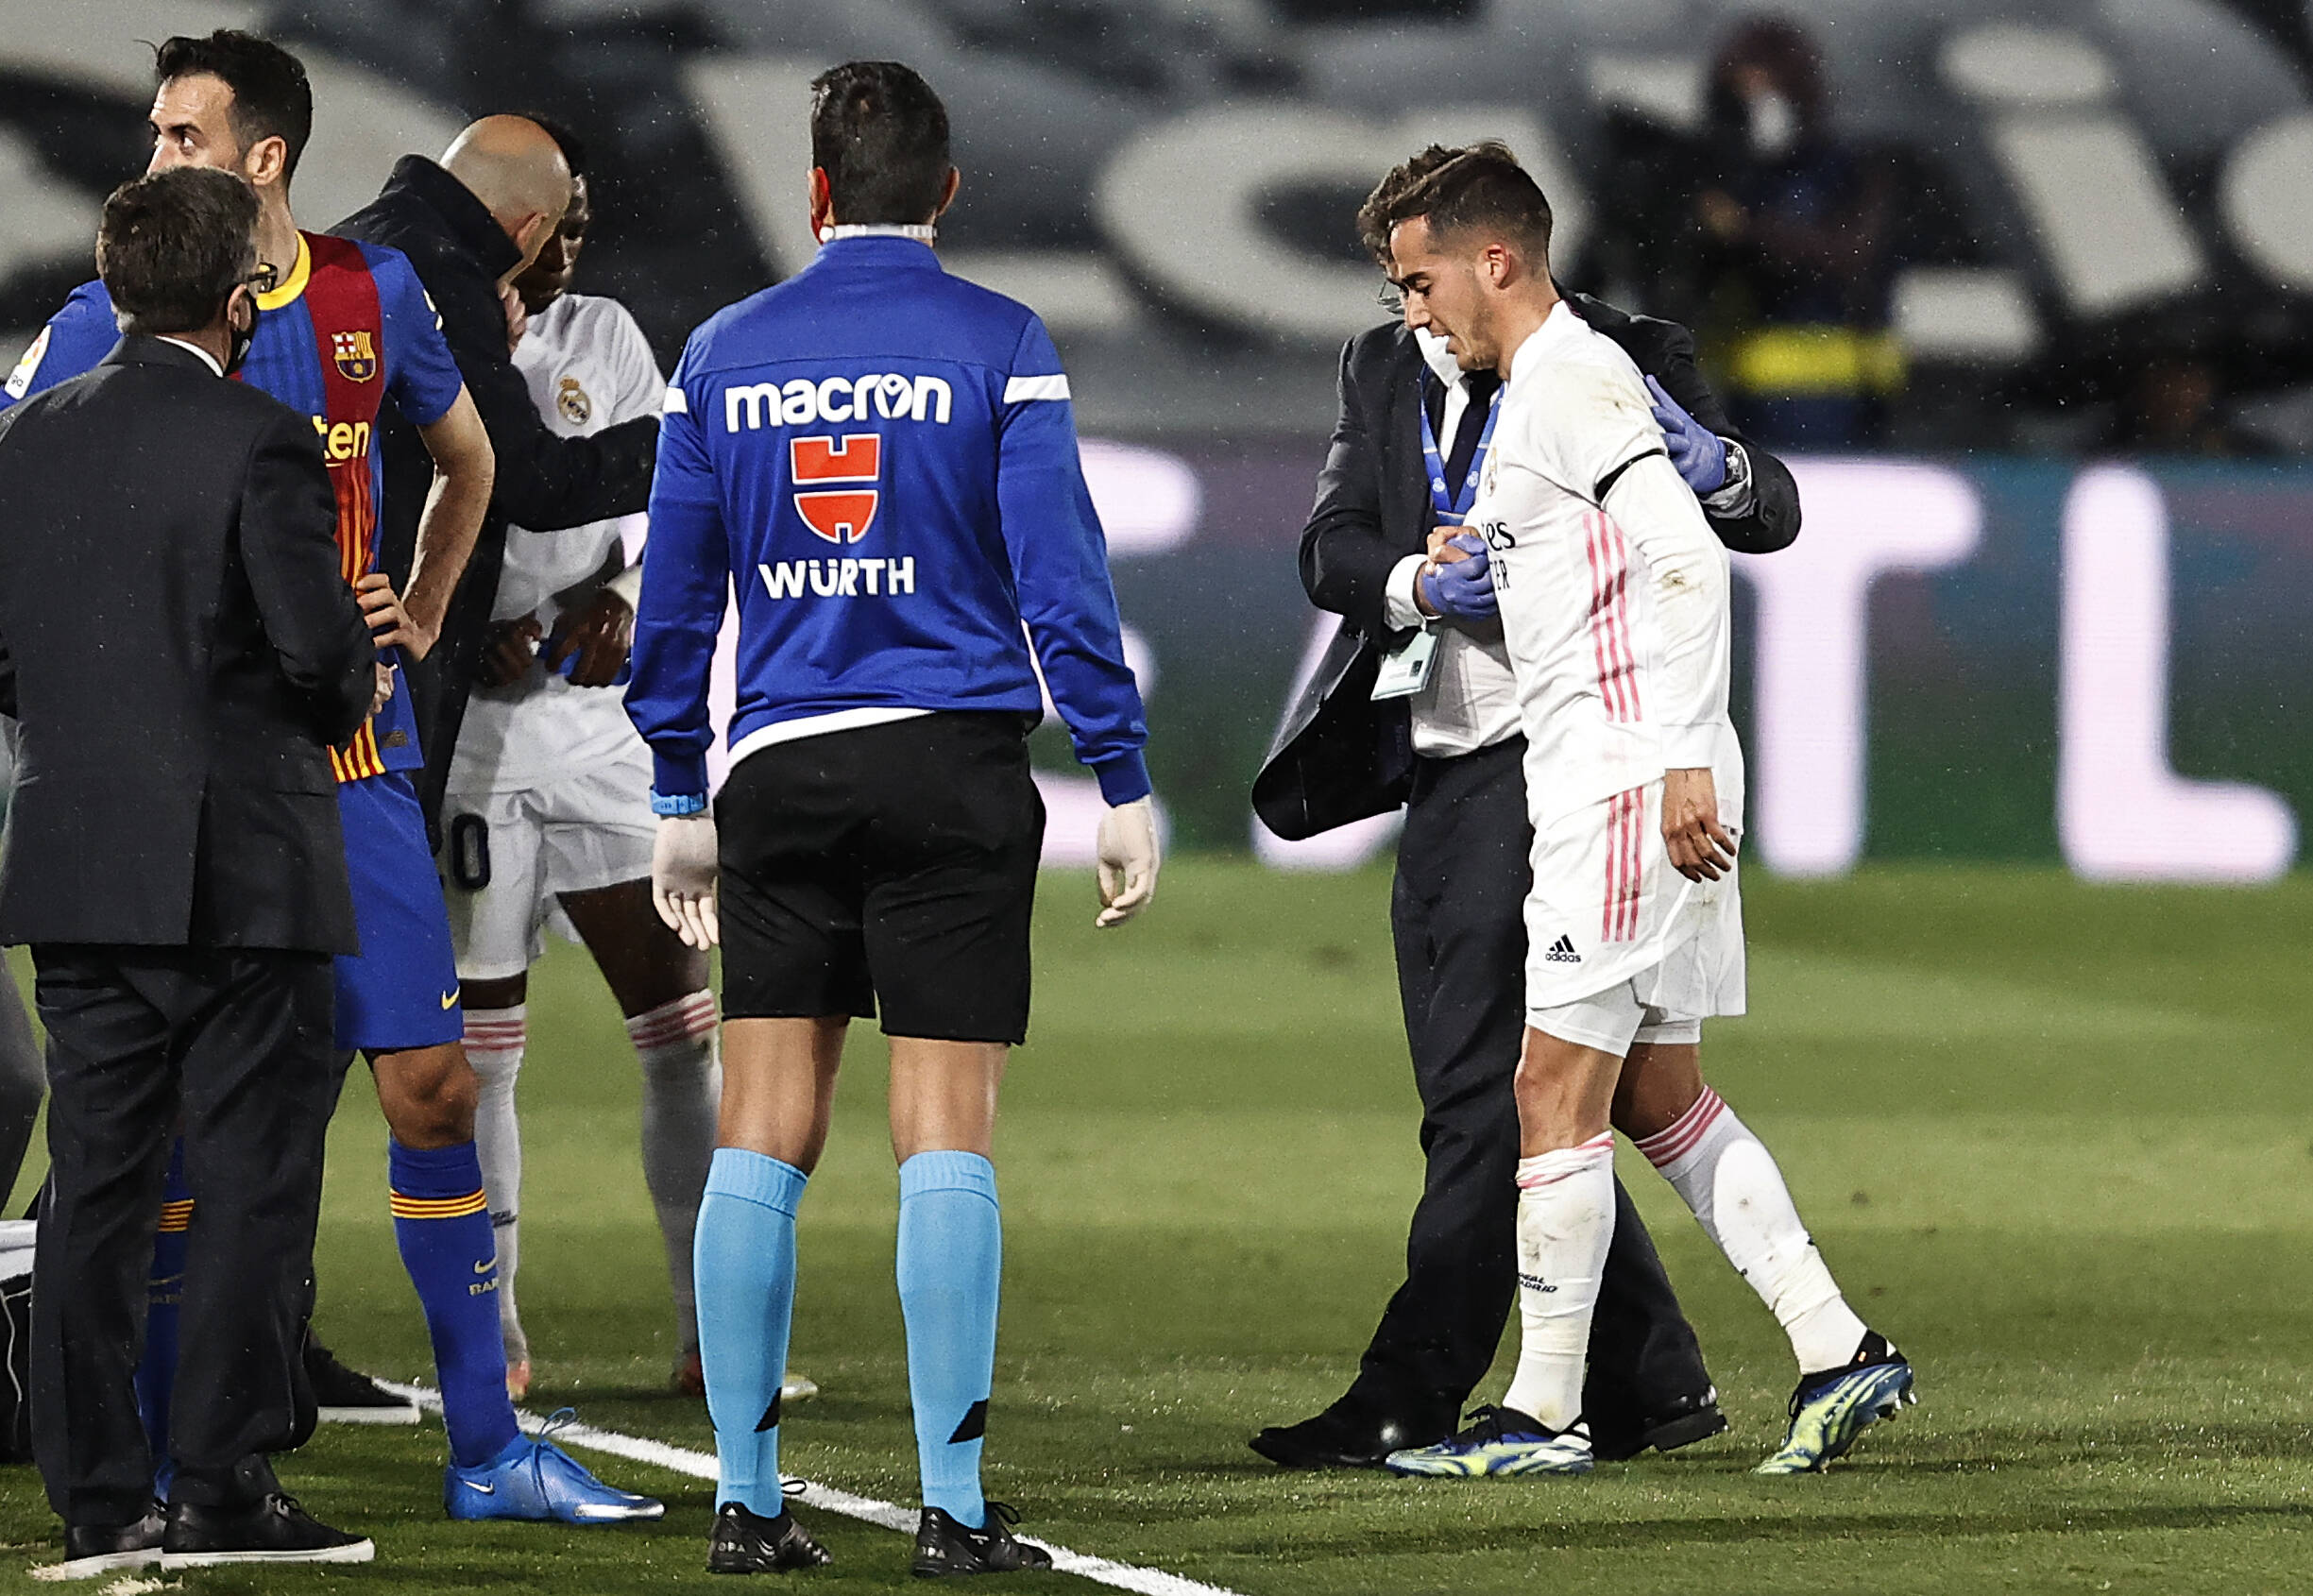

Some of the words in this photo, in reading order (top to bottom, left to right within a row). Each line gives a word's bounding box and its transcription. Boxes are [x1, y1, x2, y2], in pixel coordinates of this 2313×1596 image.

[724, 373, 952, 433] macron
[1484, 521, 1516, 552] es
[757, 556, 915, 600] WÜRTH
[1490, 559, 1510, 591] ER
[1545, 950, 1582, 963] adidas
